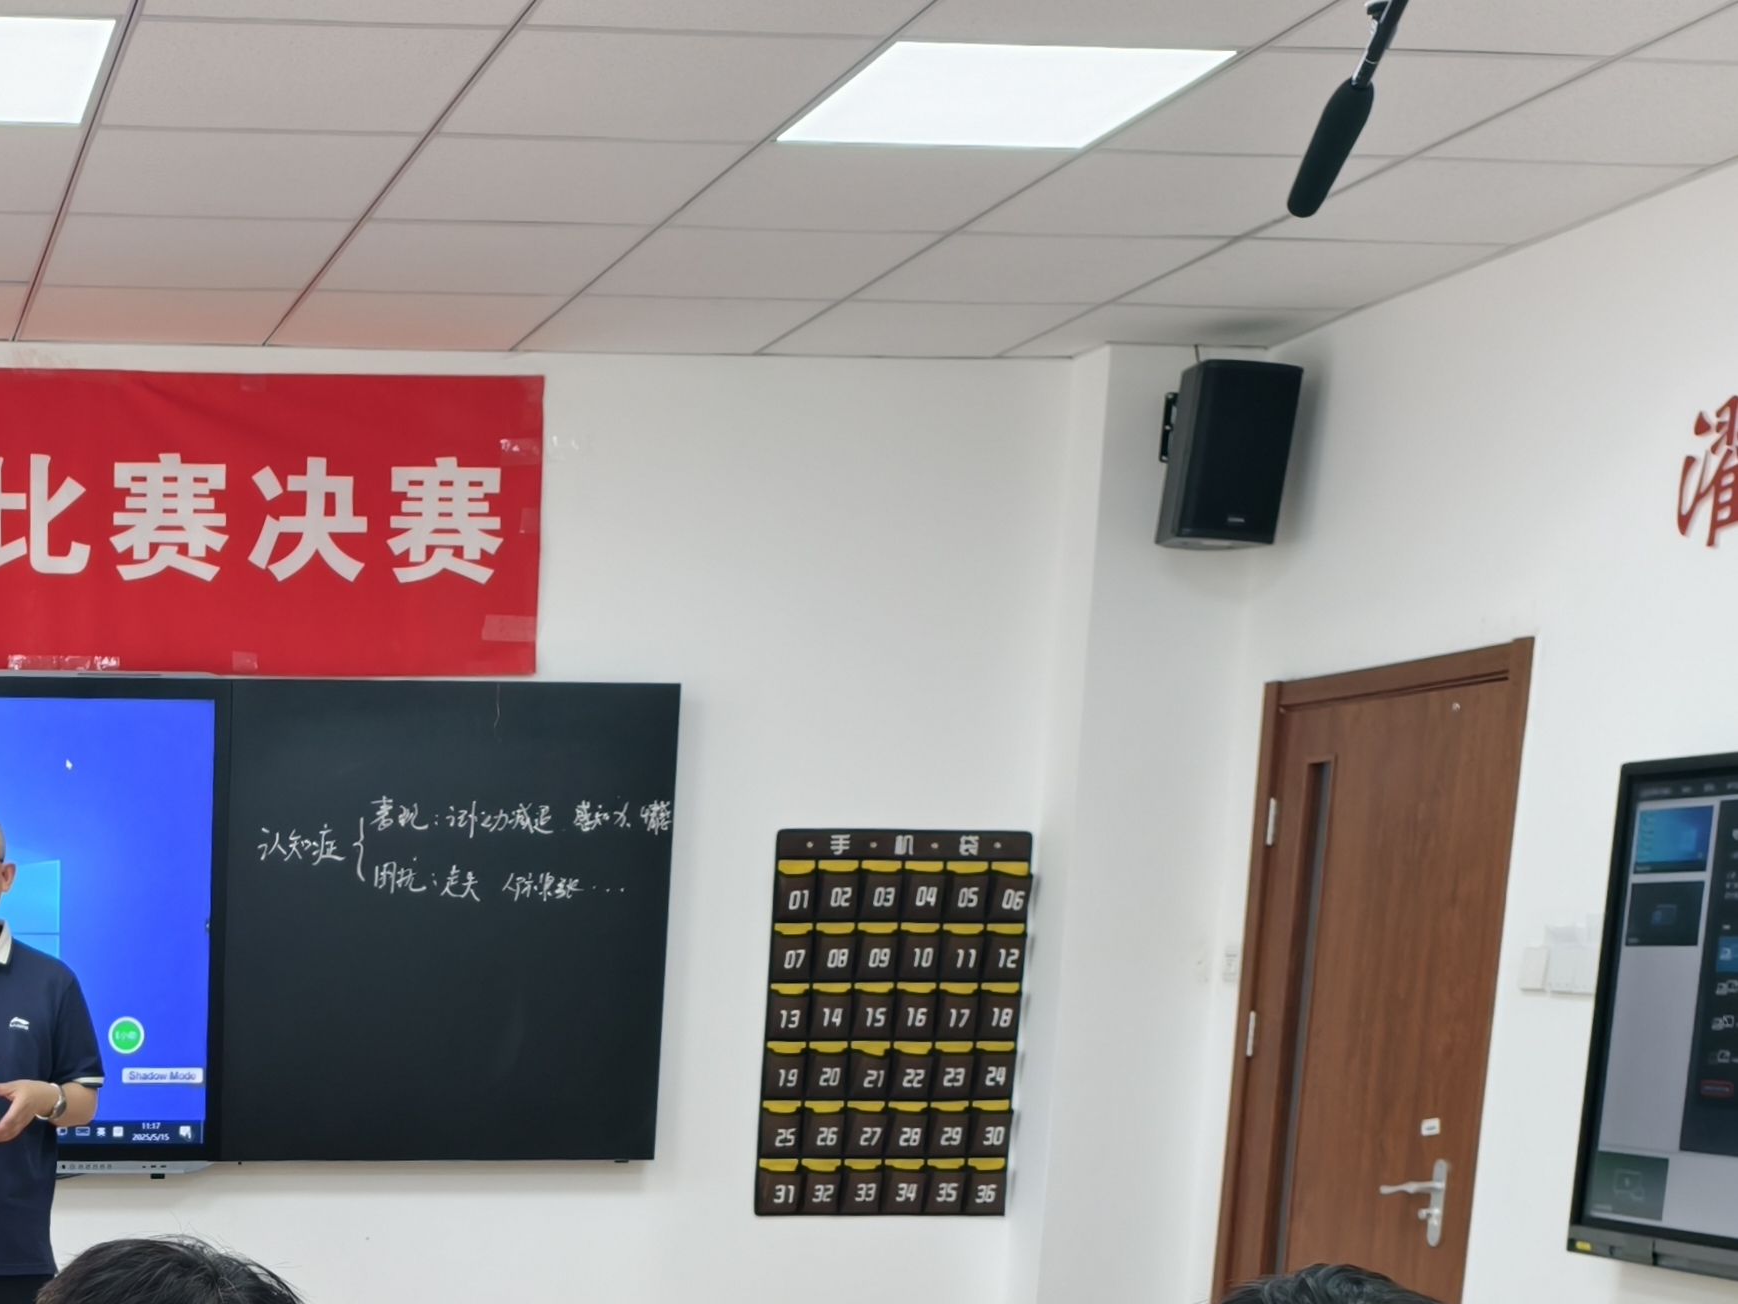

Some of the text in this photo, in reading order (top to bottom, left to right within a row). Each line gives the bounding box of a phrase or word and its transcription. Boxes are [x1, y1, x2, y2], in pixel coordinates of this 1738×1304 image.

[257, 823, 346, 866] 认知症
[829, 834, 980, 857] 手机袋
[788, 885, 1026, 911] 01 02 03 04 05 06
[783, 947, 1020, 969] 07 08 09 10 11 12
[780, 1007, 1014, 1029] 13 14 15 16 17 18
[128, 1070, 196, 1082] Shadow Mode
[779, 1066, 1007, 1088] 19 20 21 22 23 24
[132, 1133, 170, 1142] 2025/5/15
[774, 1126, 1006, 1147] 25 26 27 28 29 30
[773, 1182, 997, 1204] 31 32 33 34 35 36
